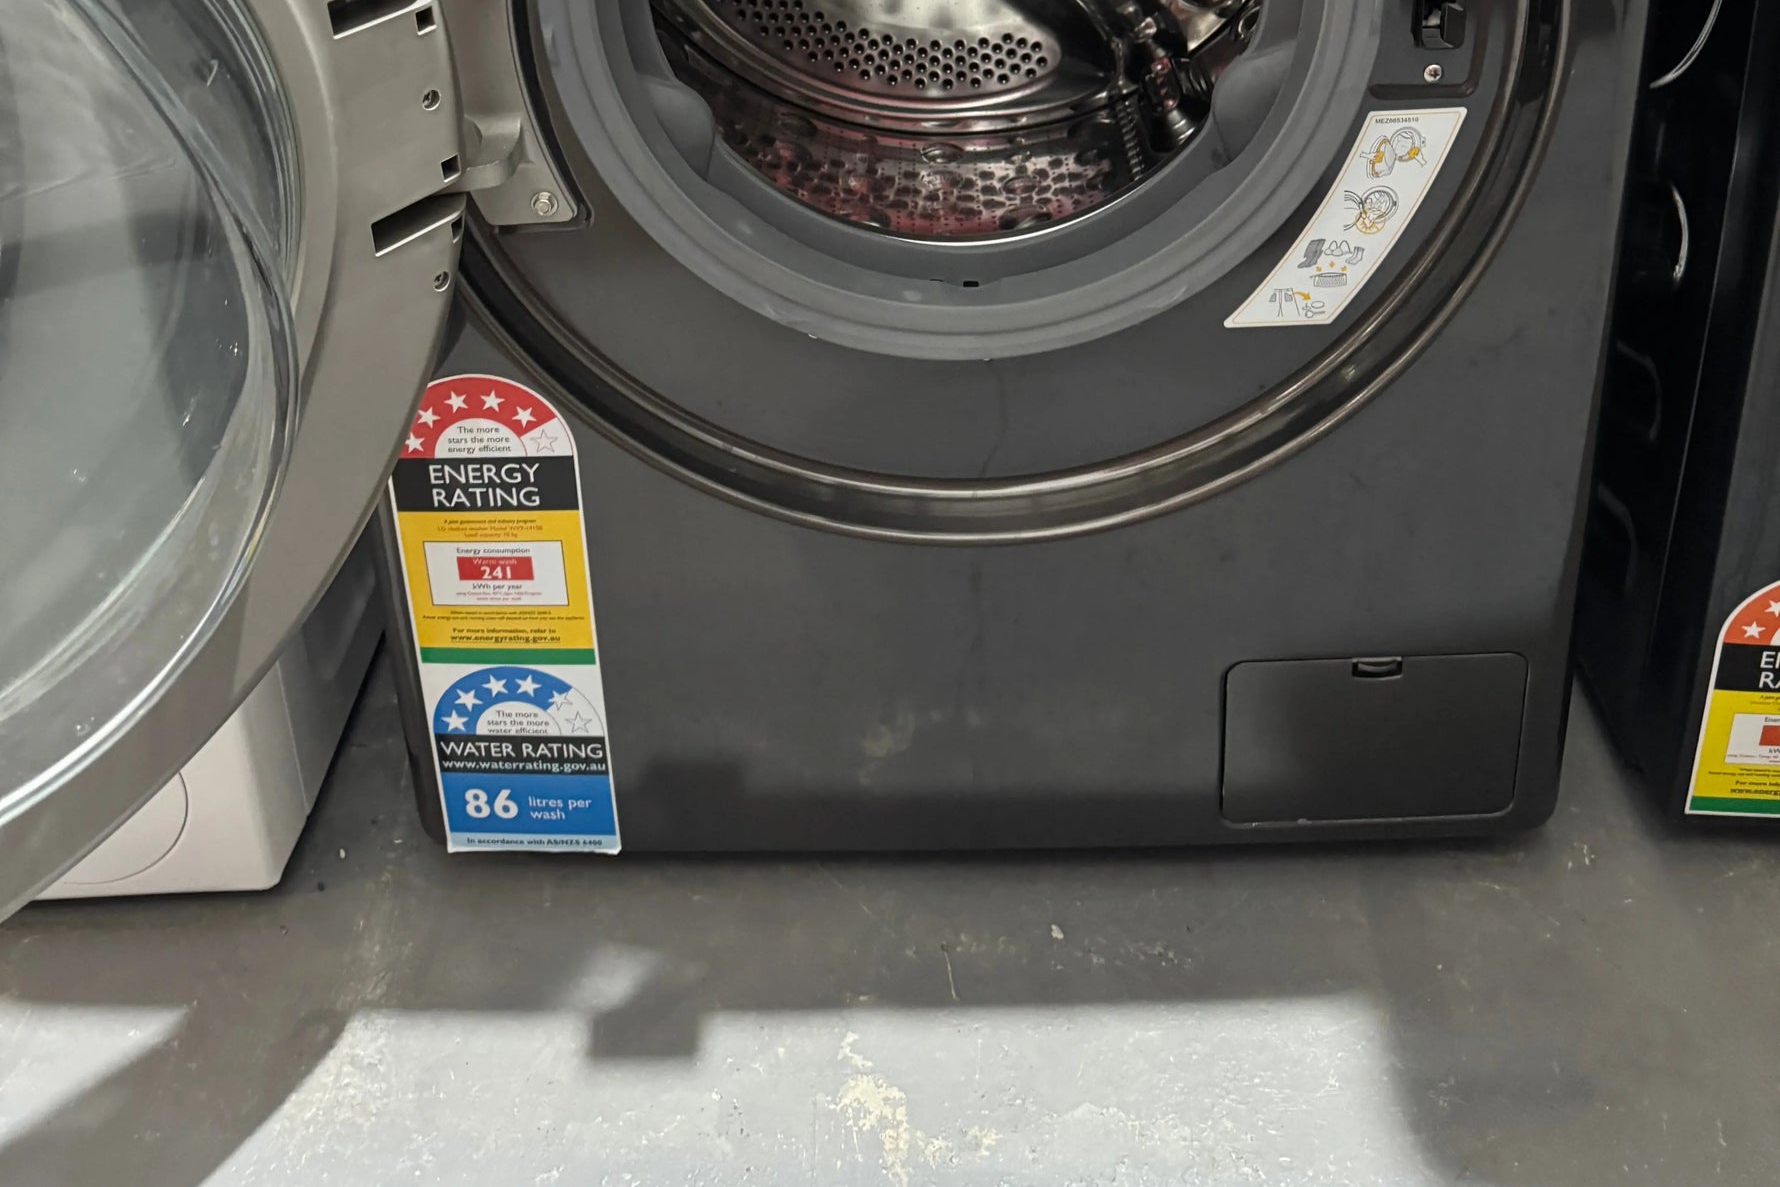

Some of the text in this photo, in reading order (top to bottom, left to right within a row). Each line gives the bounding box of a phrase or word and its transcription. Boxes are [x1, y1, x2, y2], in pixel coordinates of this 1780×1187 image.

[478, 444, 511, 452] efficient
[428, 463, 540, 484] ENERGY
[432, 487, 540, 507] RATING
[457, 547, 481, 555] Energy
[481, 566, 511, 579] 241
[496, 710, 512, 718] The
[440, 742, 603, 758] WATER RATING
[442, 760, 606, 773] www.waterrating.gov.au
[464, 788, 519, 819] 86
[528, 796, 592, 810] litres per
[530, 810, 565, 820] wash
